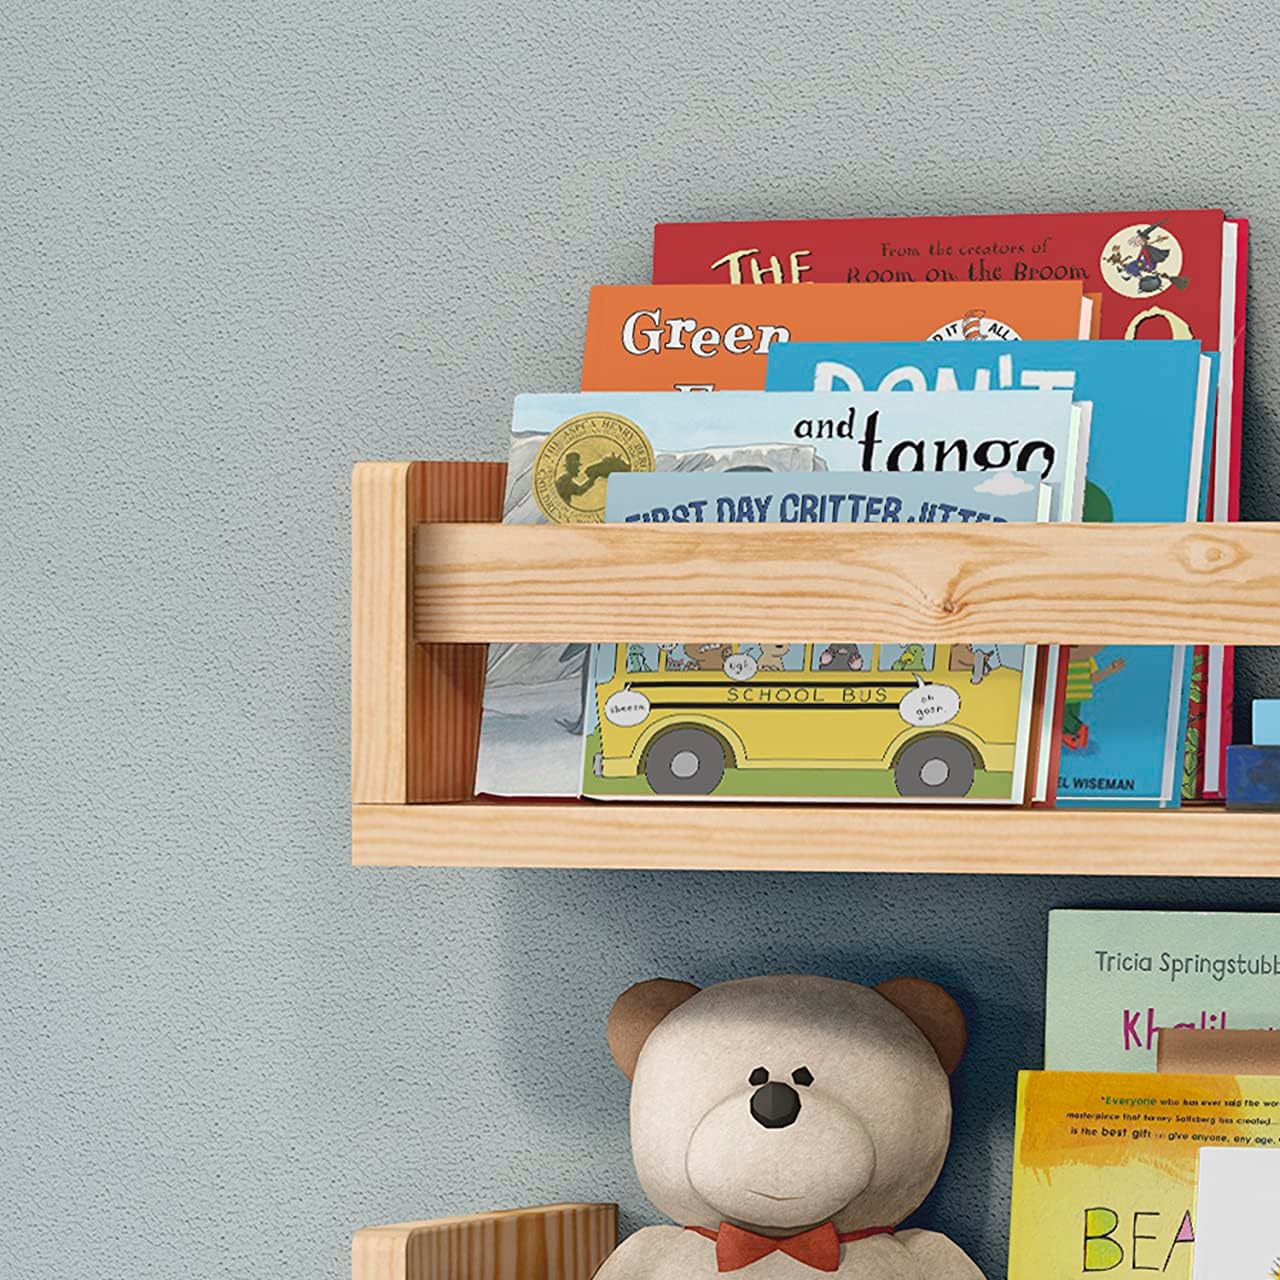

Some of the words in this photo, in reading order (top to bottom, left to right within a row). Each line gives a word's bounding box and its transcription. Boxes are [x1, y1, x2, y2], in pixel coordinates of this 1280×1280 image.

[881, 243, 920, 257] From
[929, 240, 952, 256] the
[958, 242, 1024, 256] creators
[1032, 236, 1052, 254] of
[710, 247, 813, 285] THE
[847, 267, 915, 283] Room
[925, 268, 957, 283] on
[968, 259, 1001, 281] the
[1013, 262, 1090, 281] Broom
[621, 307, 791, 357] Green
[945, 323, 958, 336] IT
[988, 322, 1011, 340] ALL
[794, 407, 856, 440] and
[858, 410, 1055, 480] tango
[716, 495, 773, 523] DAY
[780, 492, 903, 523] CRITTER
[727, 687, 825, 702] SCHOOL
[842, 688, 888, 702] BUS
[1073, 777, 1135, 790] WISEMAN
[1095, 951, 1152, 973] Tricia
[1160, 1098, 1180, 1106] who
[1183, 1098, 1199, 1106] has
[1224, 1099, 1242, 1107] said
[1244, 1099, 1260, 1107] the
[1066, 1112, 1120, 1122] masterpiece
[1123, 1112, 1141, 1121] that
[1219, 1117, 1233, 1125] has
[1071, 1127, 1079, 1135] is
[1081, 1128, 1097, 1136] the
[1101, 1127, 1127, 1137] best
[1132, 1128, 1151, 1140] gift
[1168, 1132, 1189, 1141] give
[1234, 1135, 1252, 1144] any
